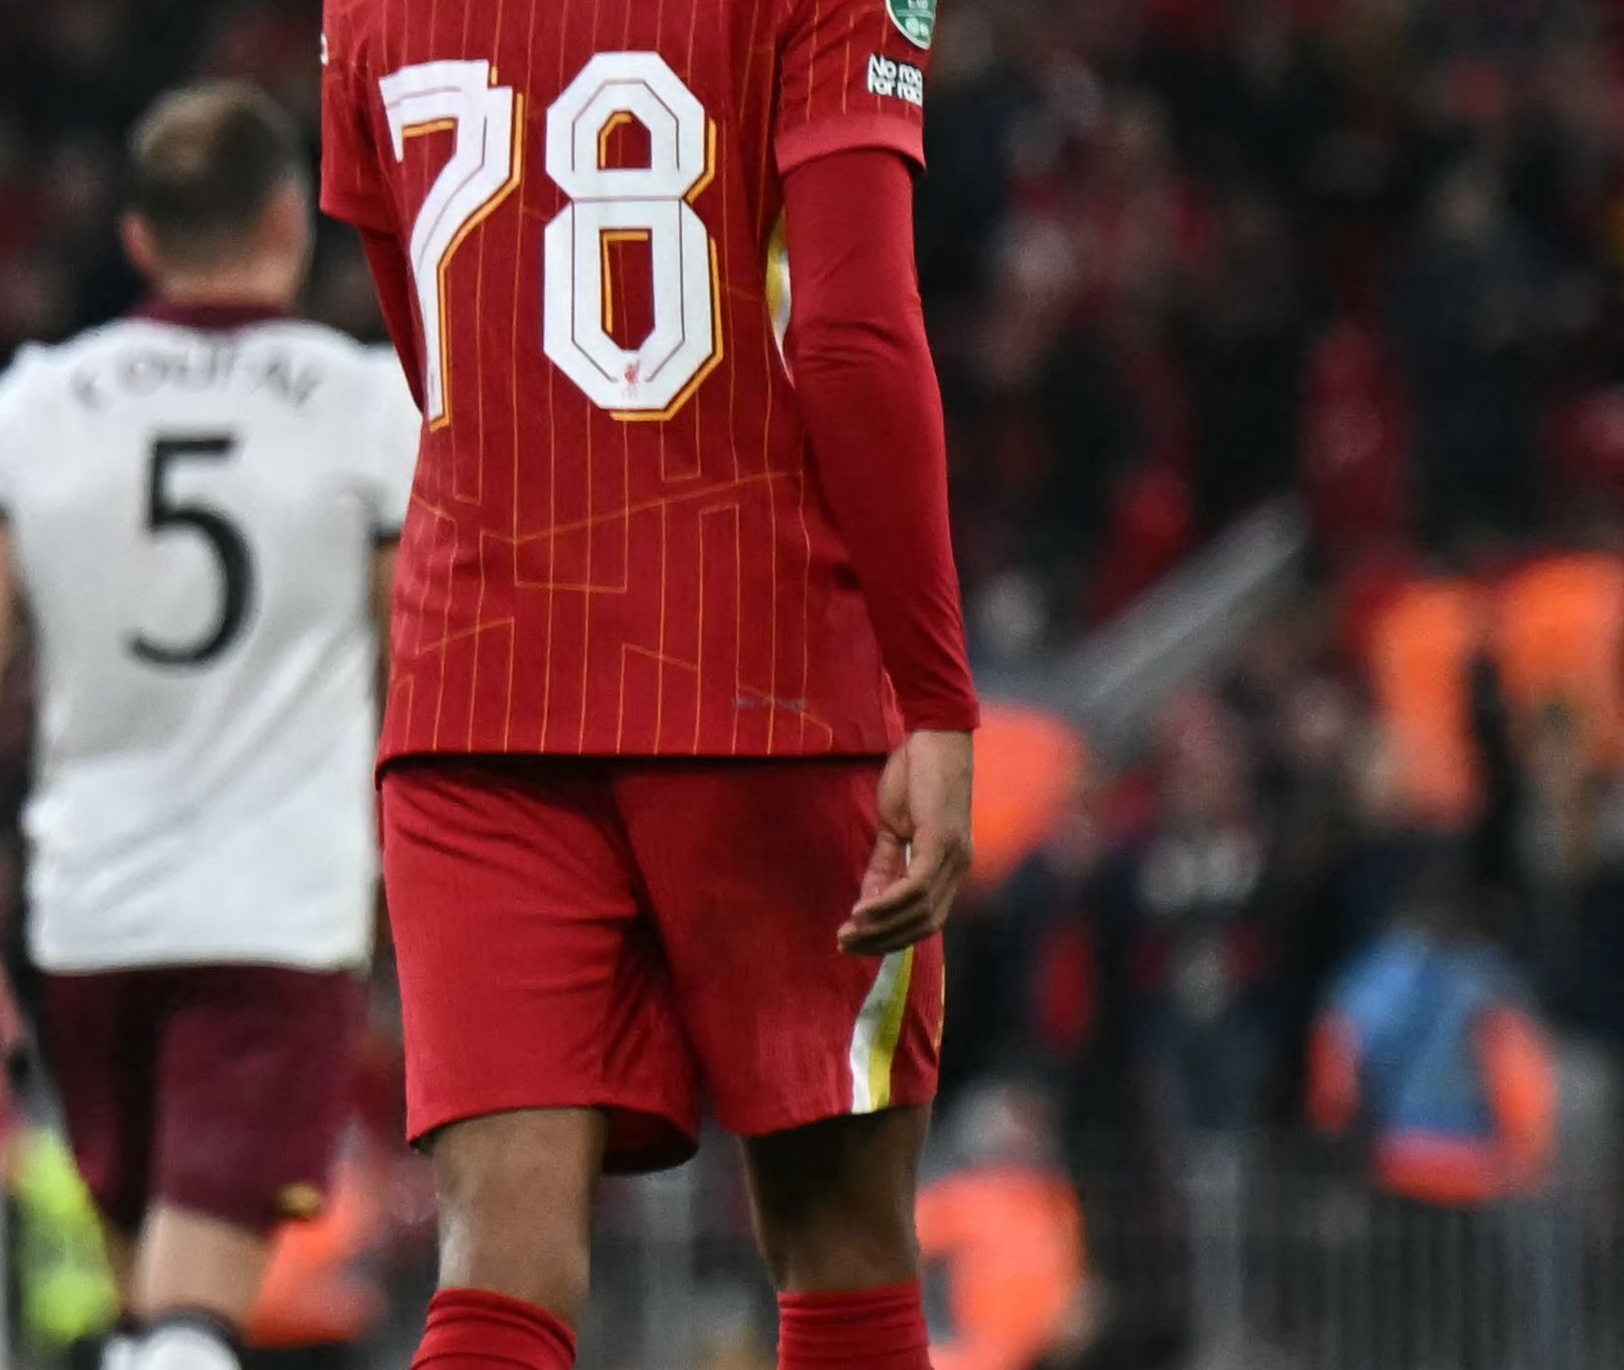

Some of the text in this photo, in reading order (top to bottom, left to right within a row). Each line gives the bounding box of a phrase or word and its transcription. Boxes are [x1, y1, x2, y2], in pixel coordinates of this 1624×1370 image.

[868, 52, 897, 80] No
[378, 51, 724, 432] 78
[127, 435, 259, 668] 5
